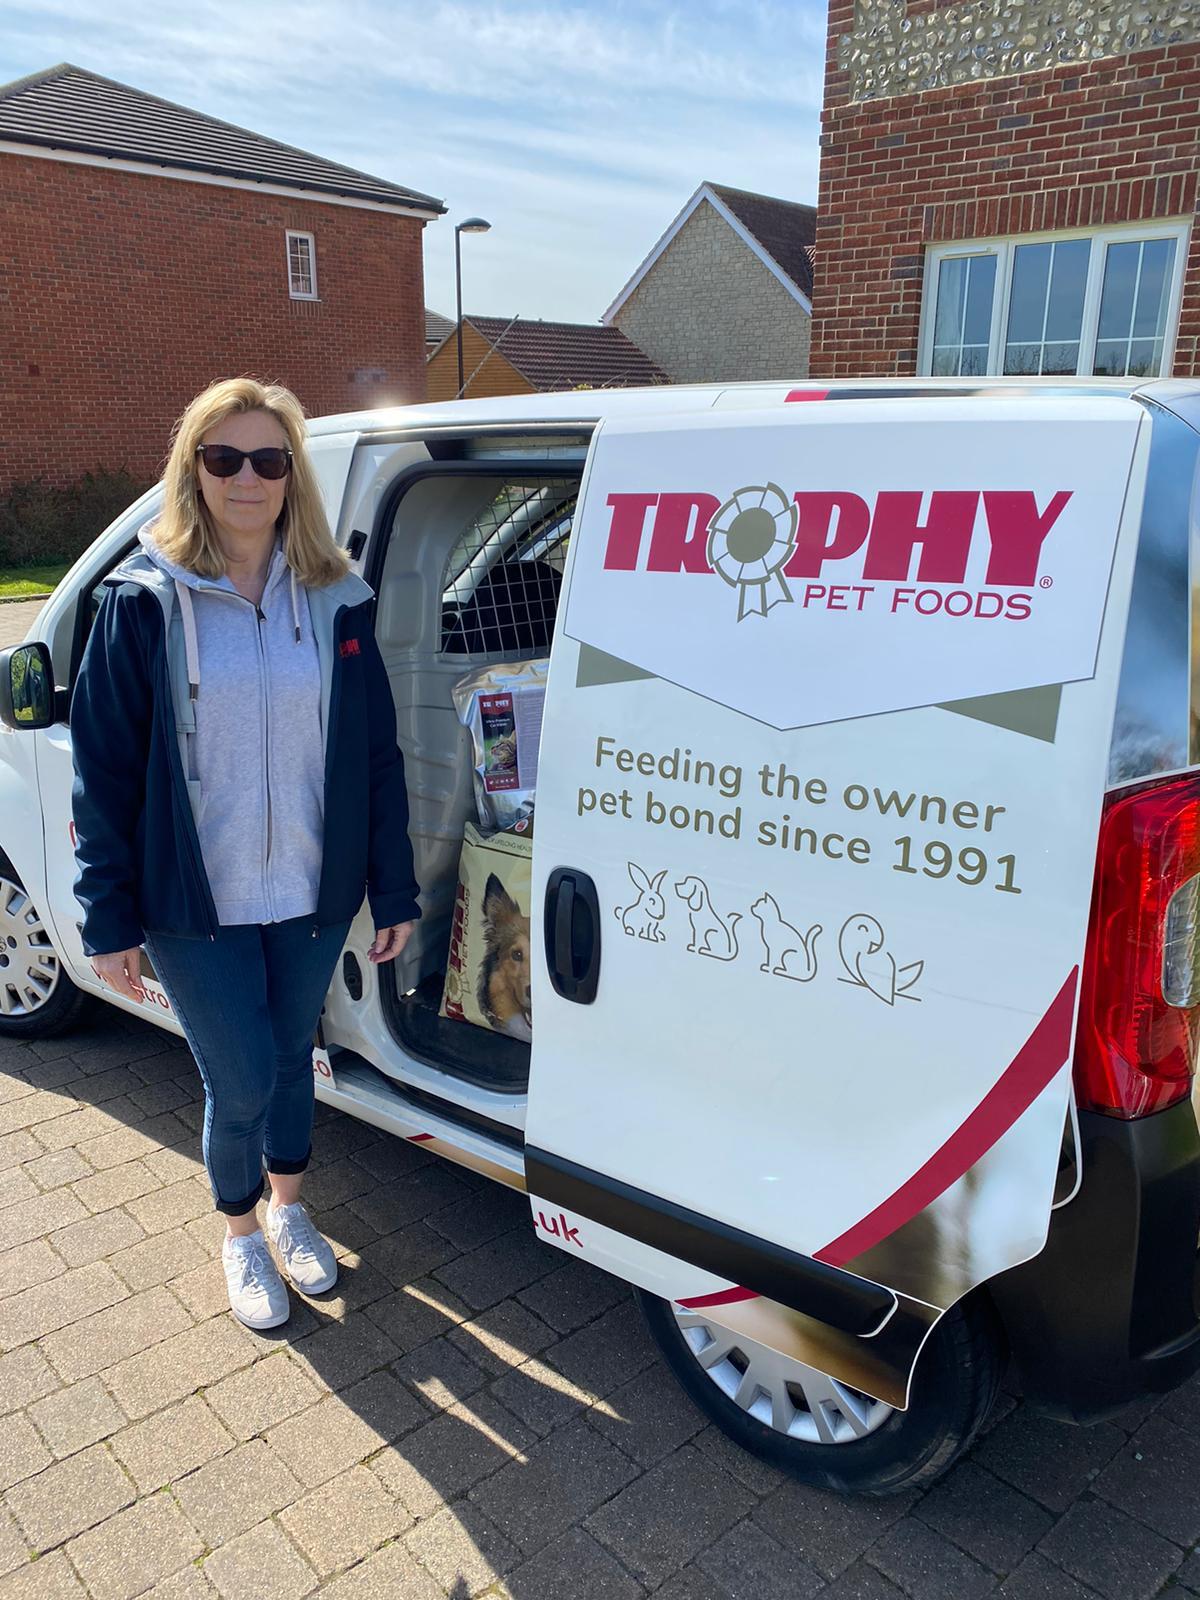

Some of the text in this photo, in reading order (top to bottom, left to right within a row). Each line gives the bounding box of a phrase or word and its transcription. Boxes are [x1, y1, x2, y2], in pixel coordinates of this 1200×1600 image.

[603, 484, 1074, 588] TROPHY
[803, 584, 1033, 620] PET FOODS
[595, 736, 743, 798] Feeding
[757, 763, 828, 805] the
[843, 784, 1006, 833] owner
[577, 787, 1022, 895] pet bond since 1991
